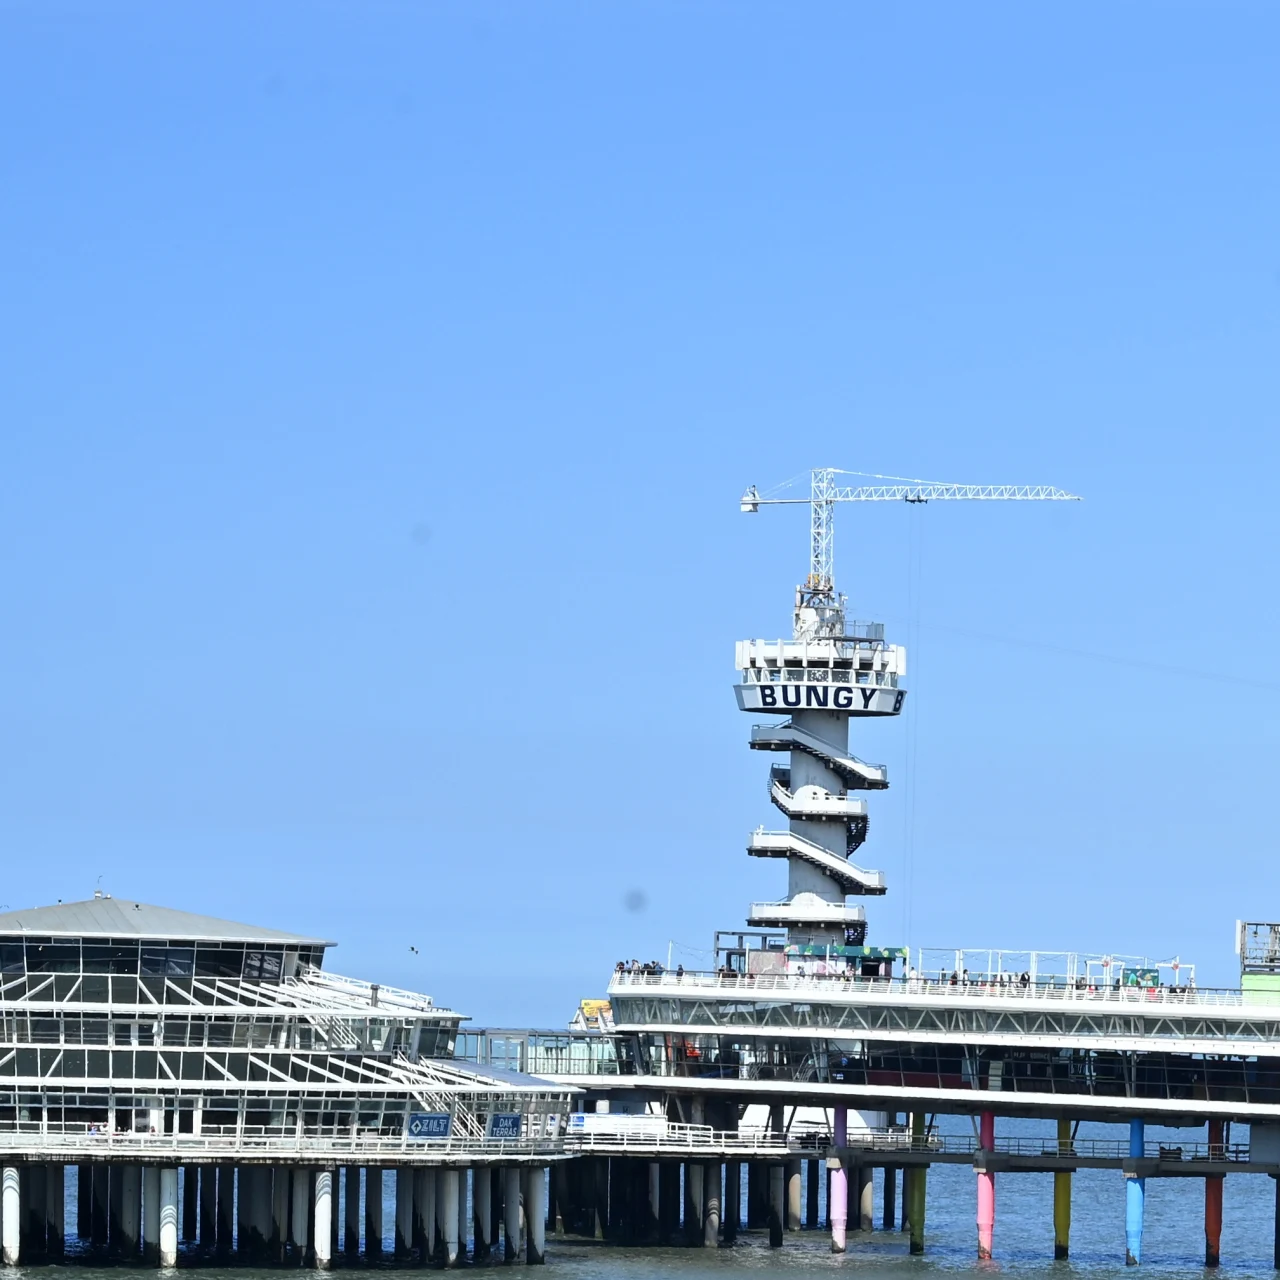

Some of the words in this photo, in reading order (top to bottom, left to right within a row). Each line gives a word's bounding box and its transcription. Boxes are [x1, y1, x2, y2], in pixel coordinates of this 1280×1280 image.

[759, 685, 878, 709] BUNGY
[421, 1120, 447, 1132] ZILT
[500, 1118, 512, 1127] DAK
[493, 1128, 517, 1137] TERRAS
